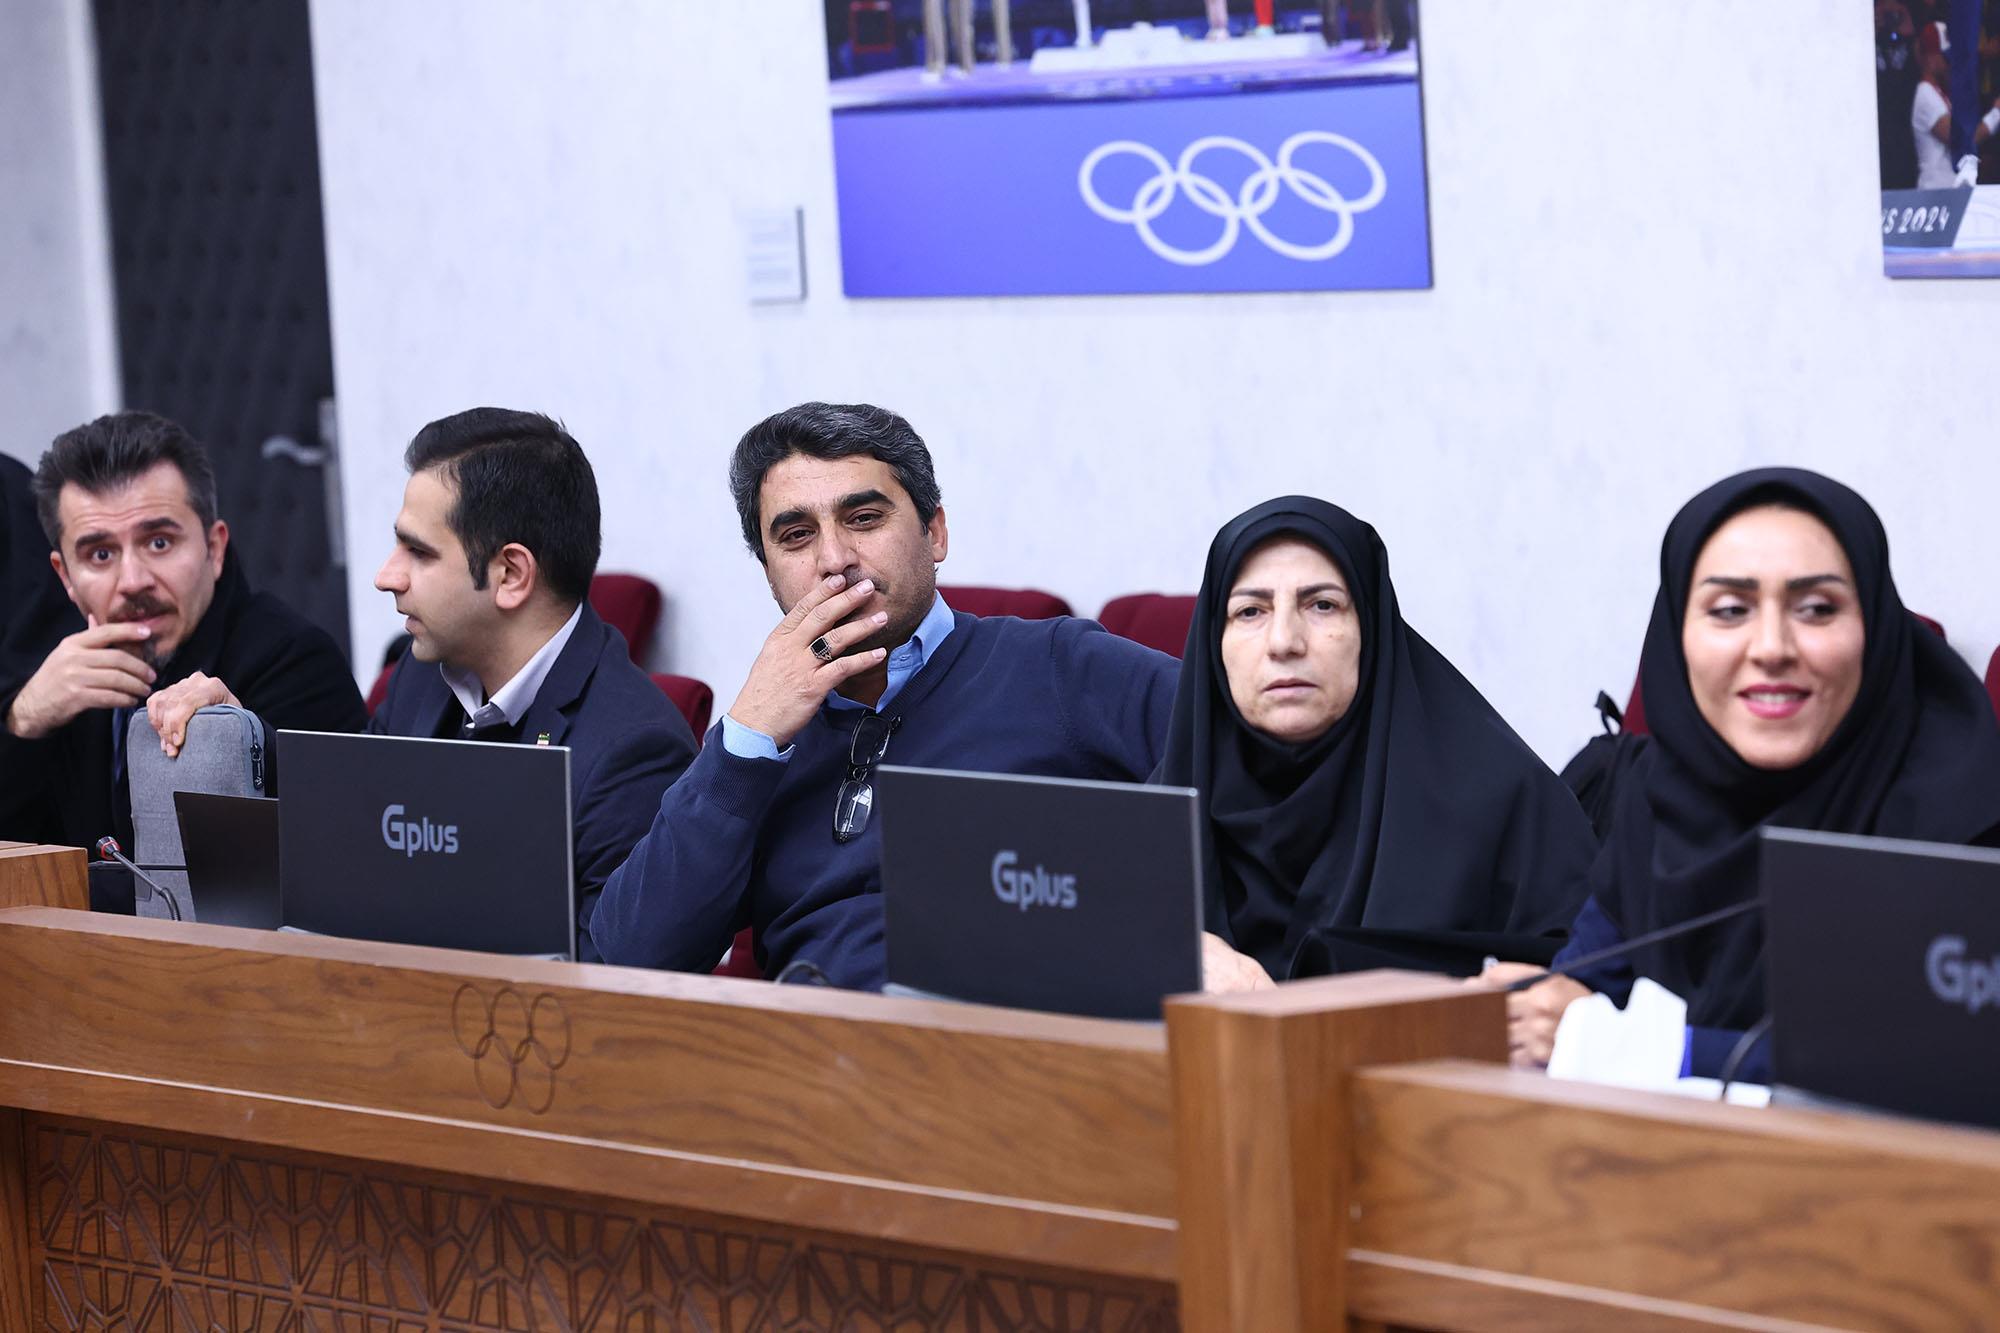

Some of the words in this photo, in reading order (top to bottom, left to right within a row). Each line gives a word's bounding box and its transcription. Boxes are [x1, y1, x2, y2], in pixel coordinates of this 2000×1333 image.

[1897, 205, 1950, 234] 2024
[382, 804, 459, 858] Gplus
[992, 850, 1078, 911] Gplus
